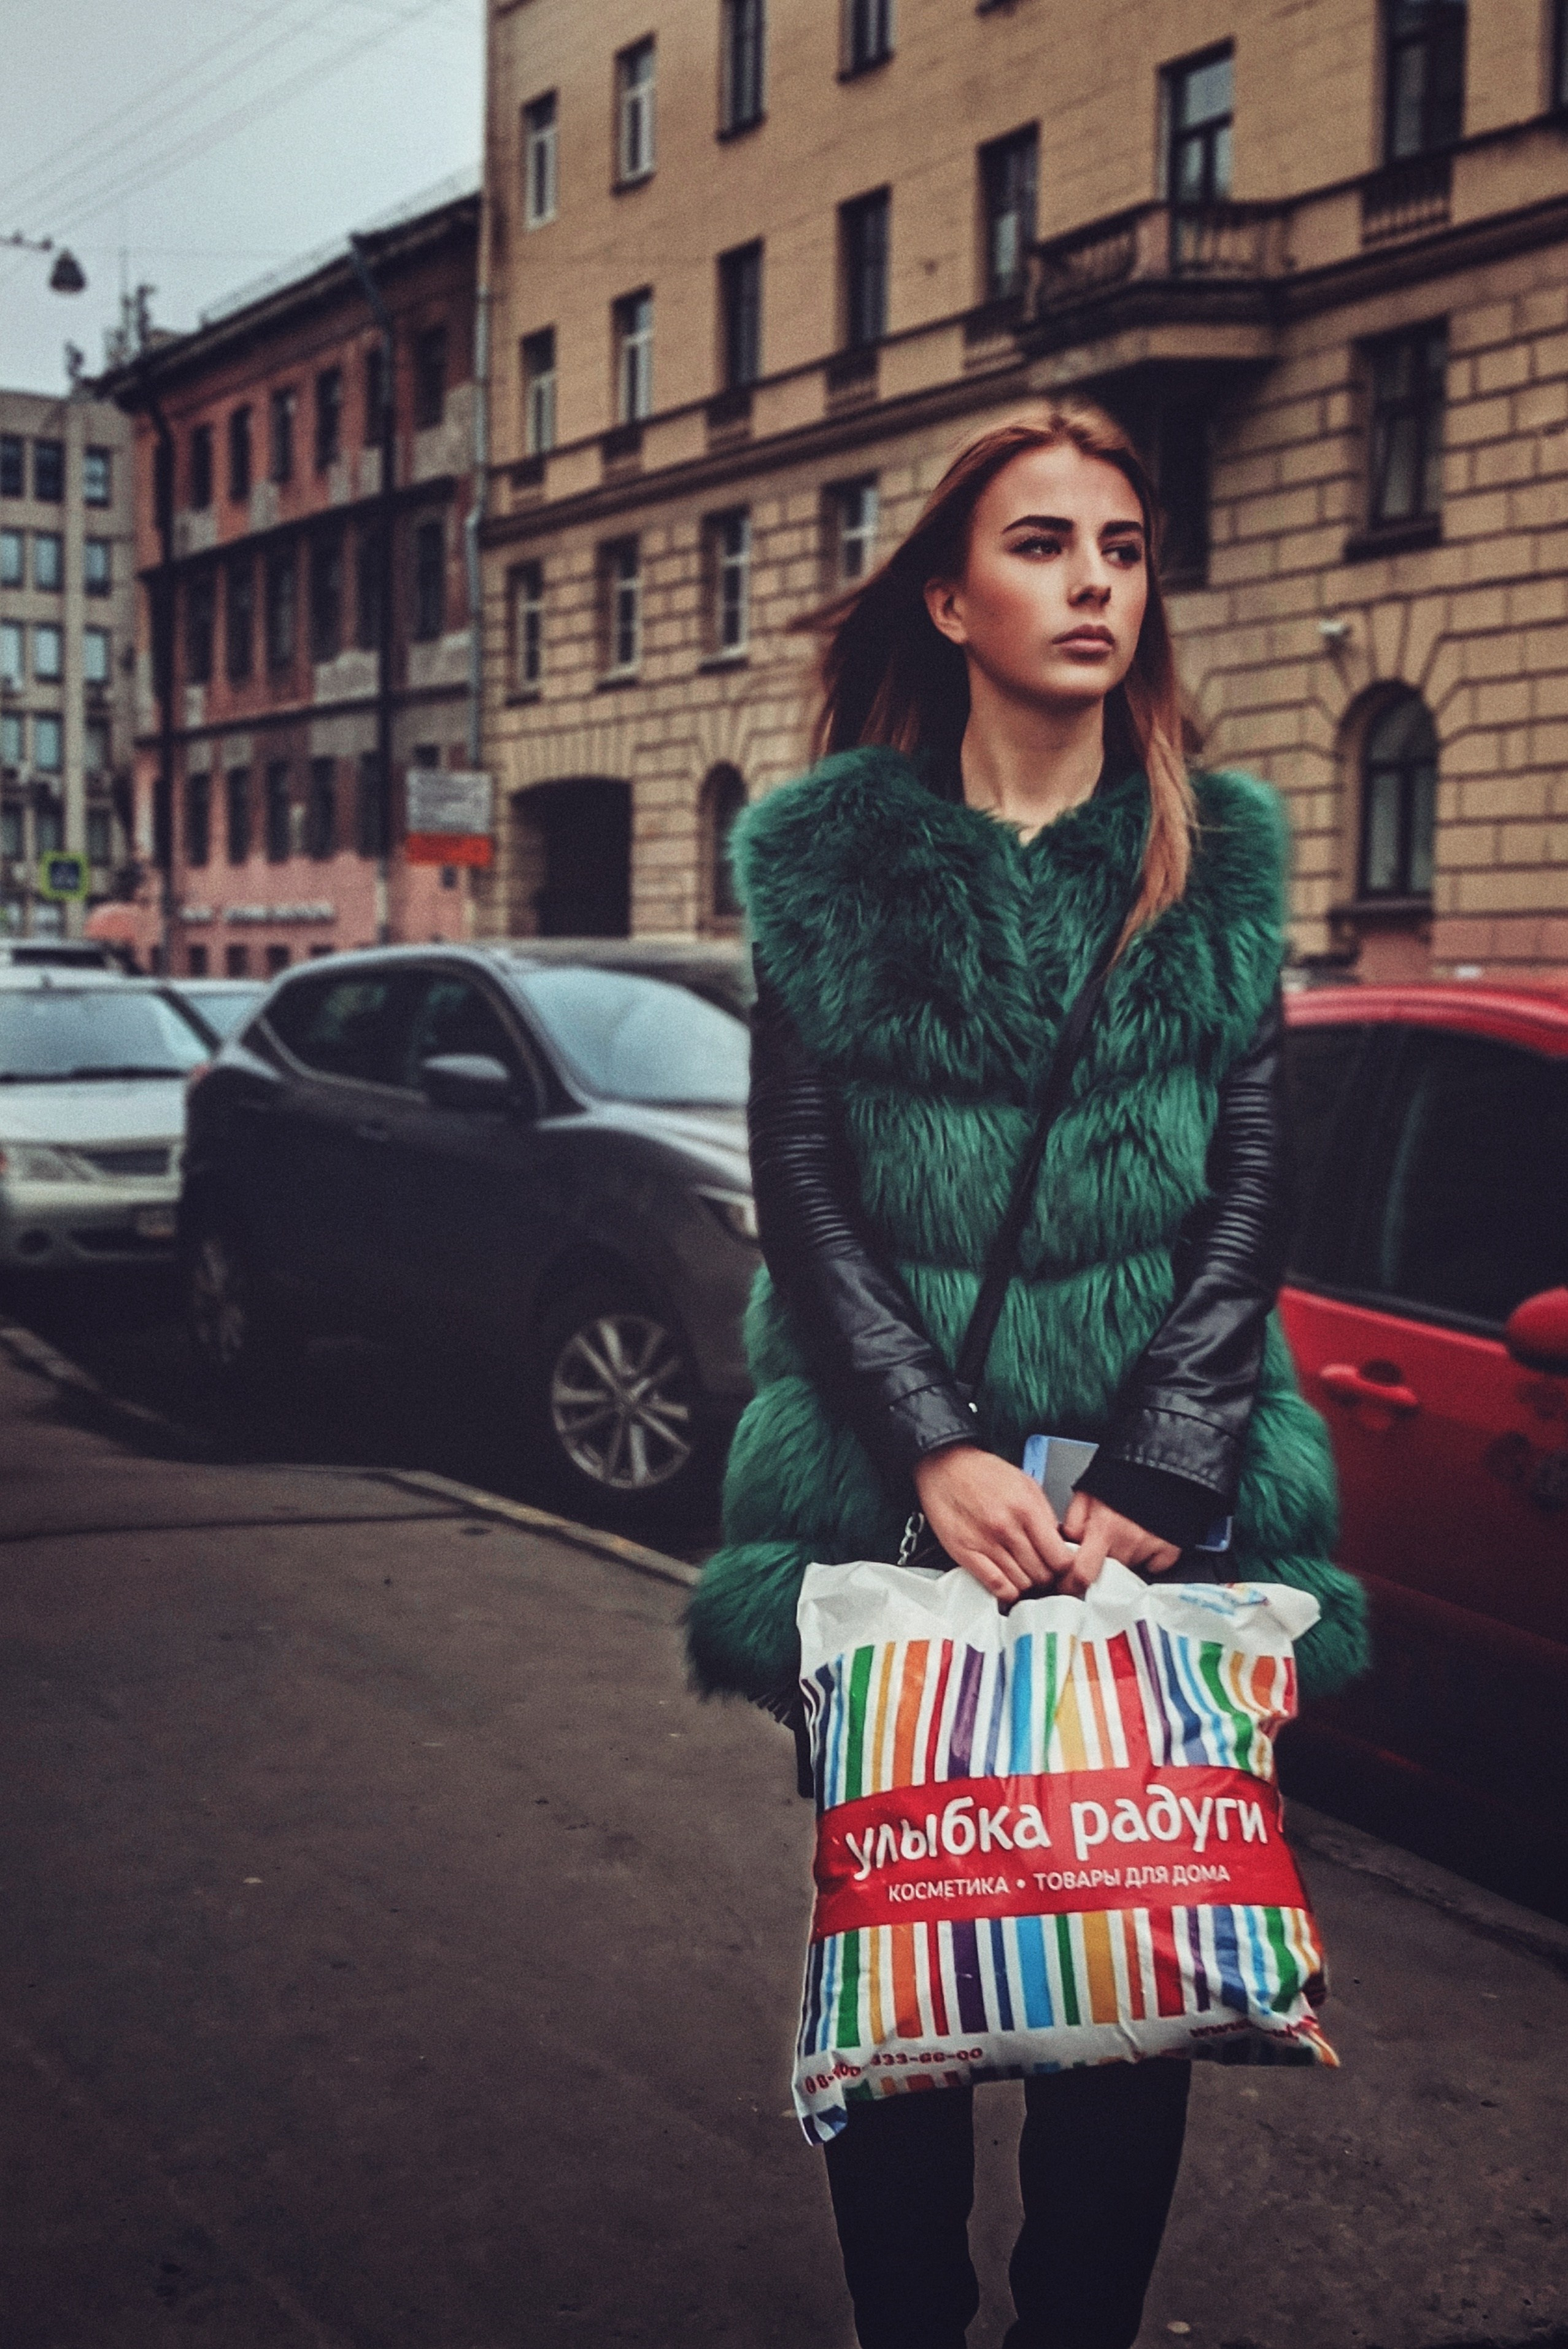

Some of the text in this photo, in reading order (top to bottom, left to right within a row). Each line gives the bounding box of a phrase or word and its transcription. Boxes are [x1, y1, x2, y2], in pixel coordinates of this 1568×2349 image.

[845, 1784, 1268, 1881] улыбка радуги
[889, 1863, 1230, 1902] КОСМЕТИКА ТОВАРЫ ДЛЯ ДОМА
